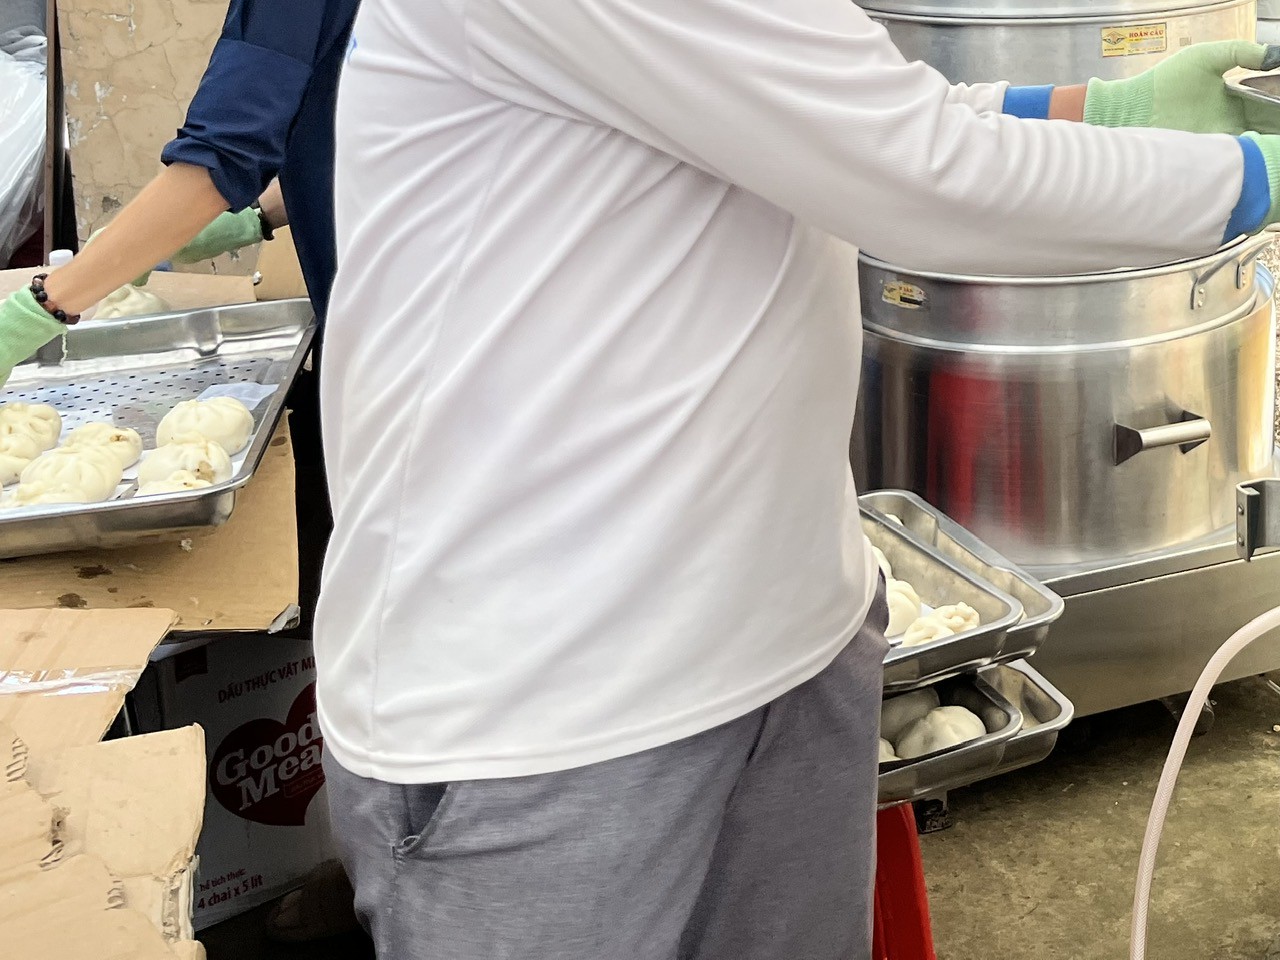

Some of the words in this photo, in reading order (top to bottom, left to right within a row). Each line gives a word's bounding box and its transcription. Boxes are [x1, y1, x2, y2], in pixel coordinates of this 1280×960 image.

[216, 711, 324, 786] Good
[236, 744, 322, 811] Mea
[197, 897, 206, 909] 4
[207, 886, 231, 907] chai
[242, 879, 250, 893] 5
